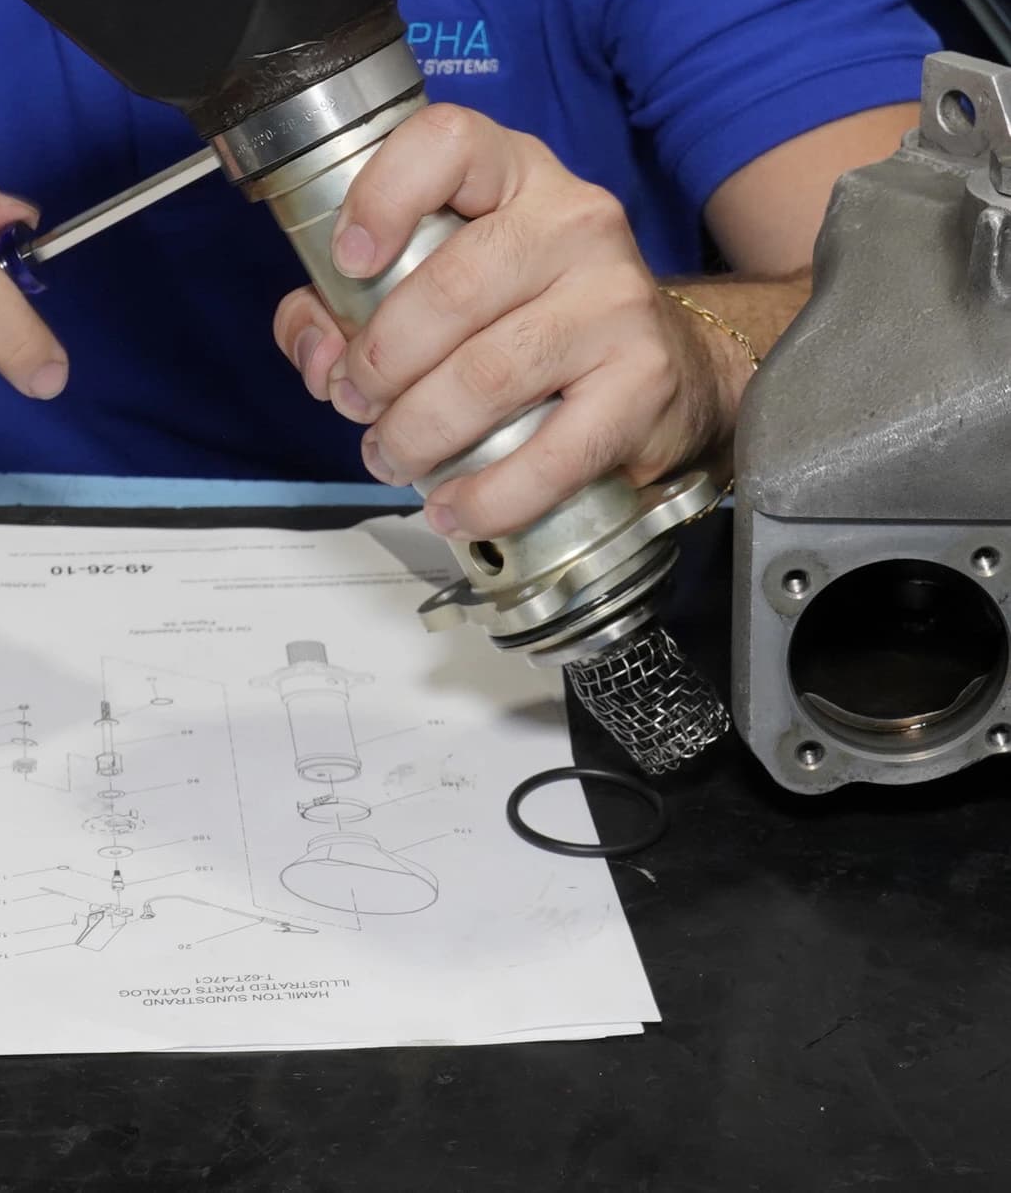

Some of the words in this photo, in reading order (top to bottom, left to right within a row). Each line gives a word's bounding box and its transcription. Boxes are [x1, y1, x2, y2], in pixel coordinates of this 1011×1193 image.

[423, 58, 499, 76] SYSTEMS
[50, 564, 153, 576] 49-26-10
[195, 973, 275, 984] T-62T-47C1
[195, 983, 246, 994] PARTS
[250, 978, 350, 992] ILLUSTRATED
[118, 986, 191, 998] CATALOG
[252, 990, 330, 1002] HAMILTON
[142, 993, 247, 1007] SUNDSTRAND
